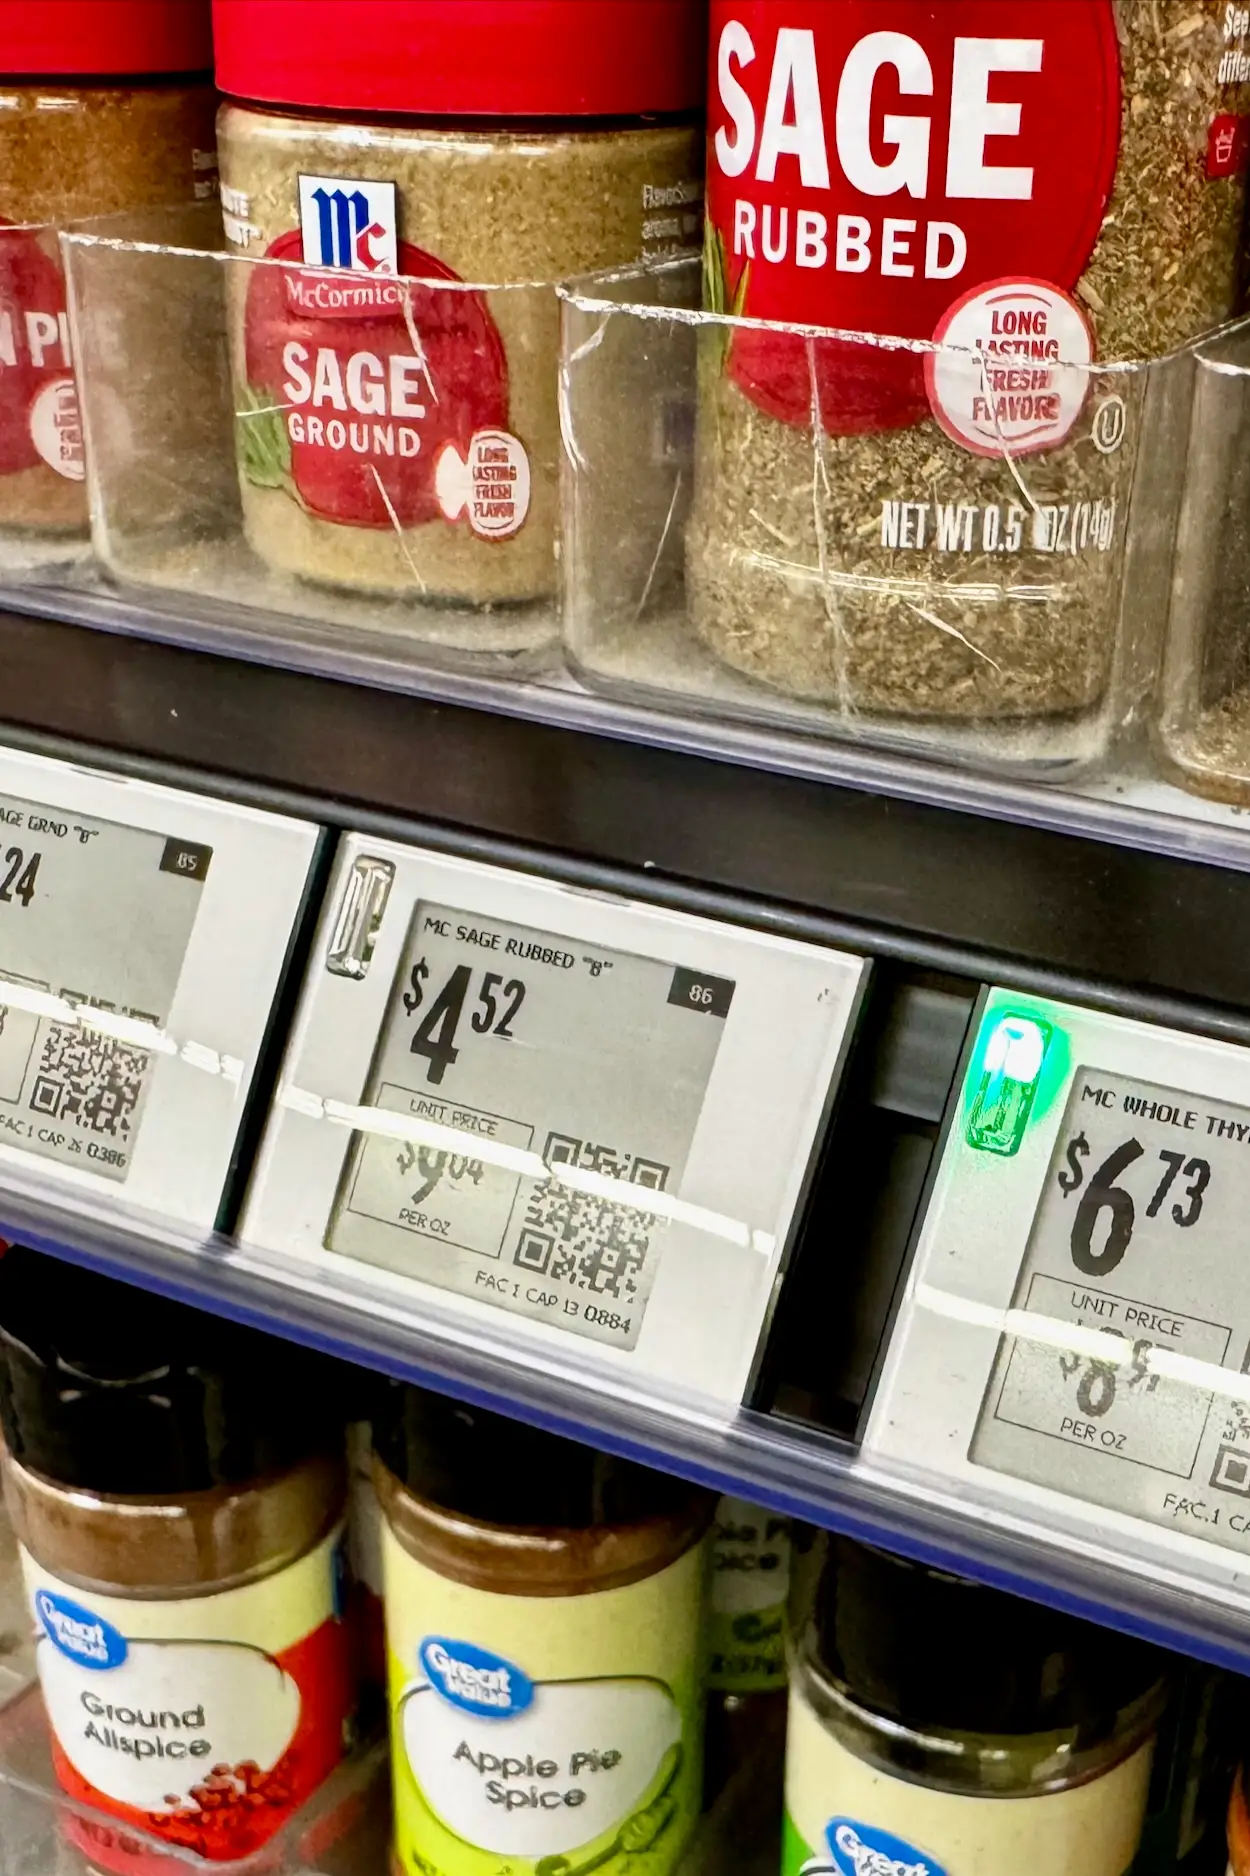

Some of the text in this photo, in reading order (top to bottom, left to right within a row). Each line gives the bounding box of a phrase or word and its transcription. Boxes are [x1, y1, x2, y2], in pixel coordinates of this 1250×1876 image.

[714, 20, 1045, 200] SAGE
[734, 199, 968, 280] RUBBED
[991, 311, 1048, 335] LONG
[283, 341, 426, 419] SAGE
[980, 370, 1050, 392] FRESH
[972, 395, 1061, 422] FLAVOR
[288, 412, 420, 457] GROUND
[881, 500, 930, 550] NET
[936, 503, 979, 552] WT
[983, 504, 1023, 552] 0.5
[28, 815, 68, 838] GRND
[424, 917, 451, 937] MC
[456, 926, 501, 951] SAGE
[505, 938, 575, 969] RUBBED
[689, 984, 715, 1004] 86
[452, 1110, 499, 1136] PRICE
[1081, 1085, 1116, 1109] MC
[1123, 1095, 1198, 1130] WHOLE
[399, 1207, 452, 1236] PER OZ
[475, 1270, 509, 1294] FAC
[526, 1288, 559, 1307] CAP
[563, 1299, 580, 1316] 13
[584, 1305, 632, 1334] 0884
[1070, 1290, 1185, 1338] UNIT PRICE
[1060, 1416, 1128, 1450] PER OZ
[80, 1690, 206, 1729] Ground
[83, 1720, 213, 1761] Allspice
[453, 1740, 623, 1779] Apple Pie
[485, 1780, 588, 1812] Spice
